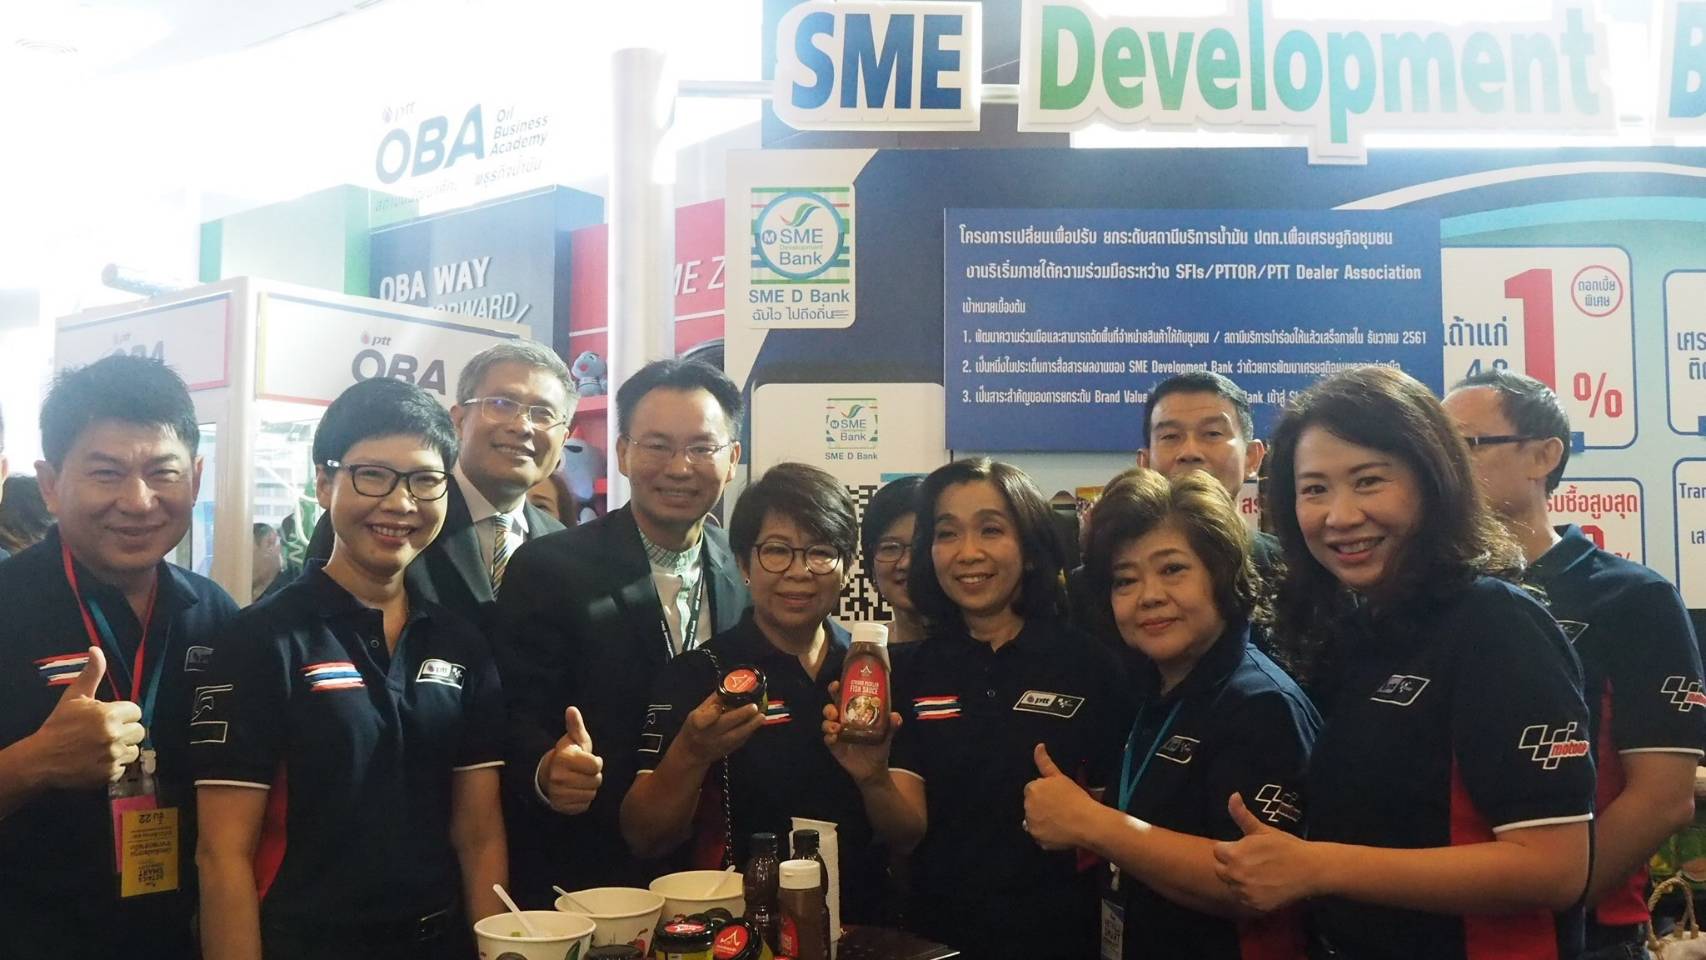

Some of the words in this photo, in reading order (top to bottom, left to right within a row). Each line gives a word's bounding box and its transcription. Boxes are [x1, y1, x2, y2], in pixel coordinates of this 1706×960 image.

[791, 11, 963, 110] SME
[1040, 0, 1601, 144] Development
[496, 107, 514, 123] Oil
[493, 115, 549, 140] Business
[376, 103, 485, 184] OBA
[489, 132, 548, 157] Academy
[780, 228, 823, 244] SME
[959, 223, 1097, 245] โครงการเปลี่ยนเพื่อปรับ
[1104, 225, 1248, 245] ยกระดับสถานีบริการน้ำมัน
[779, 252, 823, 265] Bank
[966, 259, 1170, 280] งานริเริ่มภายใต้ความร่วมมือระหว่าง
[1296, 264, 1339, 280] Dealer
[1344, 263, 1422, 280] Association
[380, 271, 426, 302] OBA
[434, 256, 492, 294] WAY
[749, 289, 784, 303] SME
[792, 290, 803, 303] D
[810, 289, 850, 303] Bank
[963, 330, 972, 344] 1.
[1402, 330, 1427, 345] 2561
[1443, 315, 1508, 346] ถ้าแก่
[372, 335, 391, 347] ptt
[352, 350, 447, 396] OBA
[962, 359, 972, 374] 2.
[1128, 359, 1148, 374] SME
[1151, 359, 1207, 376] Development
[1211, 359, 1233, 375] Bank
[962, 389, 972, 404] 3.
[1094, 389, 1121, 404] Brand
[1123, 389, 1148, 404] Value
[840, 419, 867, 429] SME
[840, 432, 867, 441] Bank
[825, 452, 844, 460] SME
[857, 452, 878, 460] Bank
